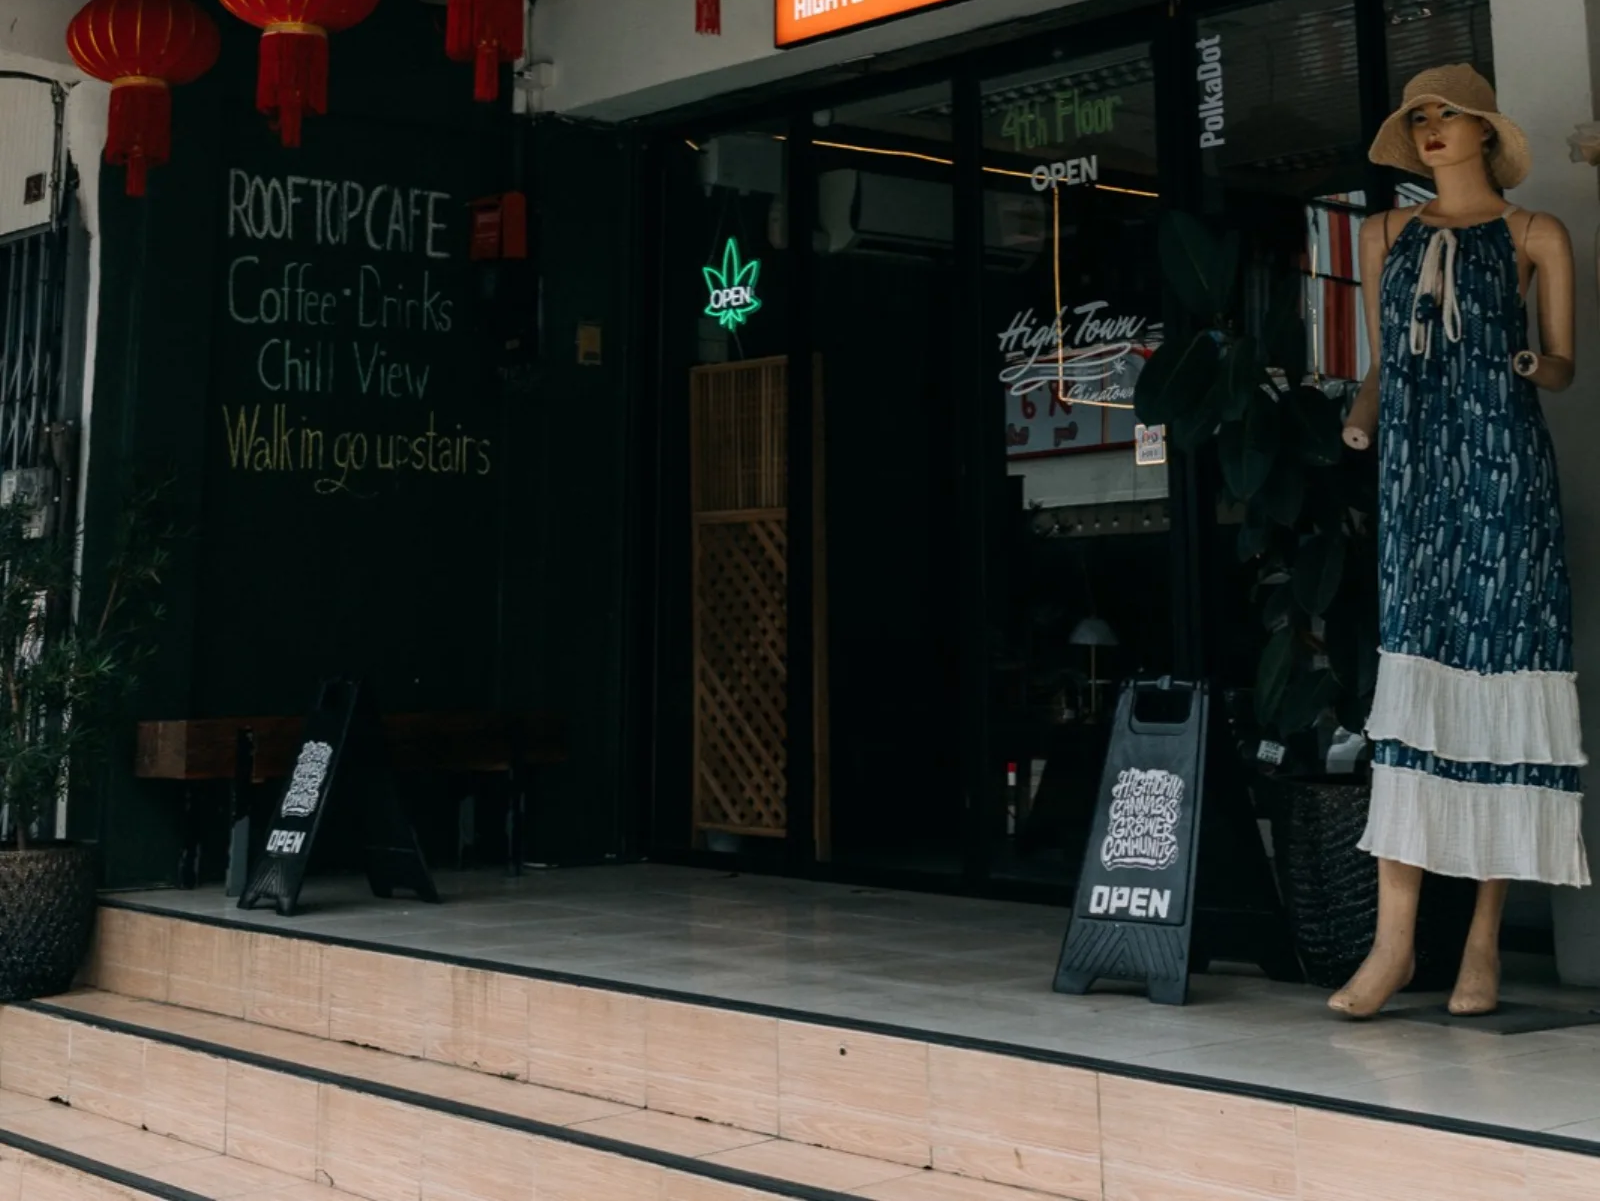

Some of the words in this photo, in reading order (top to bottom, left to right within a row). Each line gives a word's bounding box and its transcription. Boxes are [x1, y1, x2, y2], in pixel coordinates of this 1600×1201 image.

[1195, 34, 1226, 149] PolkaDot
[1001, 99, 1049, 152] 4th
[1055, 87, 1124, 144] Floor
[1031, 155, 1099, 192] OPEN
[228, 255, 338, 326] Coffee
[710, 286, 752, 309] OPEN
[998, 306, 1070, 367] High
[1073, 300, 1147, 345] Town
[257, 338, 336, 394] Chill
[352, 340, 431, 401] View
[222, 402, 295, 472] Walk
[300, 415, 324, 471] in
[314, 432, 369, 495] go
[1110, 795, 1180, 824] CANNABIS
[266, 829, 306, 854] OPEN
[1111, 816, 1176, 842] GROWER
[1101, 835, 1177, 865] COMMUNITY
[1089, 884, 1172, 919] OPEN
